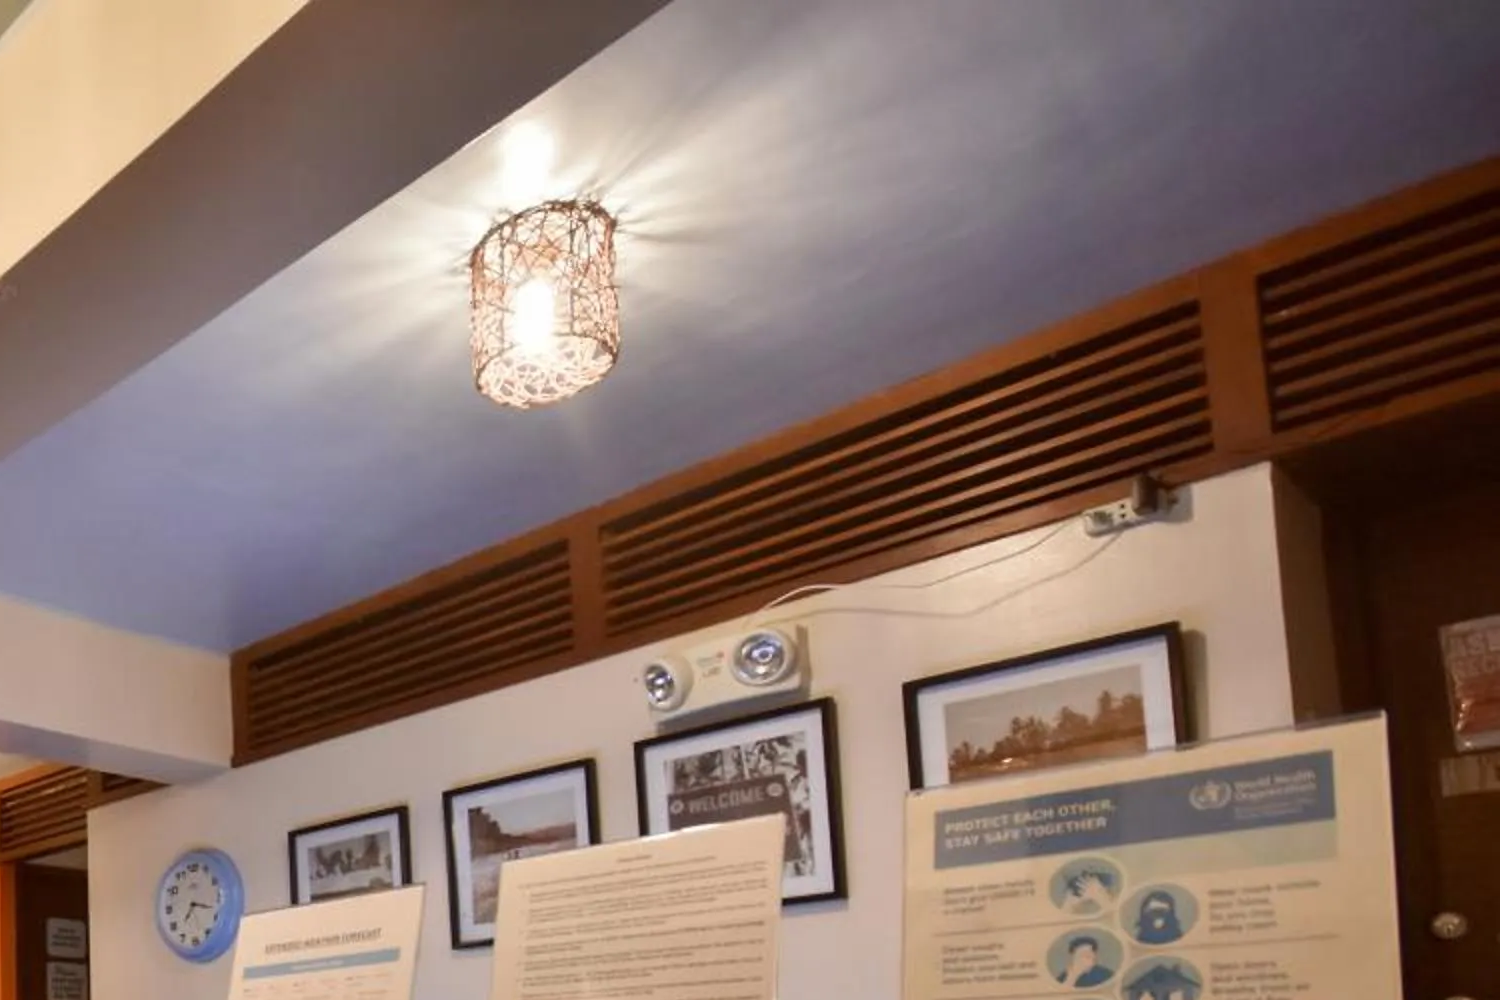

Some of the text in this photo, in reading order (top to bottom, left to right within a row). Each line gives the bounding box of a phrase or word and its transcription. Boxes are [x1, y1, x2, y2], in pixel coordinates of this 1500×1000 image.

[688, 785, 765, 813] WELCOME
[944, 814, 1010, 834] PROTECT
[1013, 807, 1055, 825] EACH
[944, 816, 1108, 849] STAY SAFE TOGETHER
